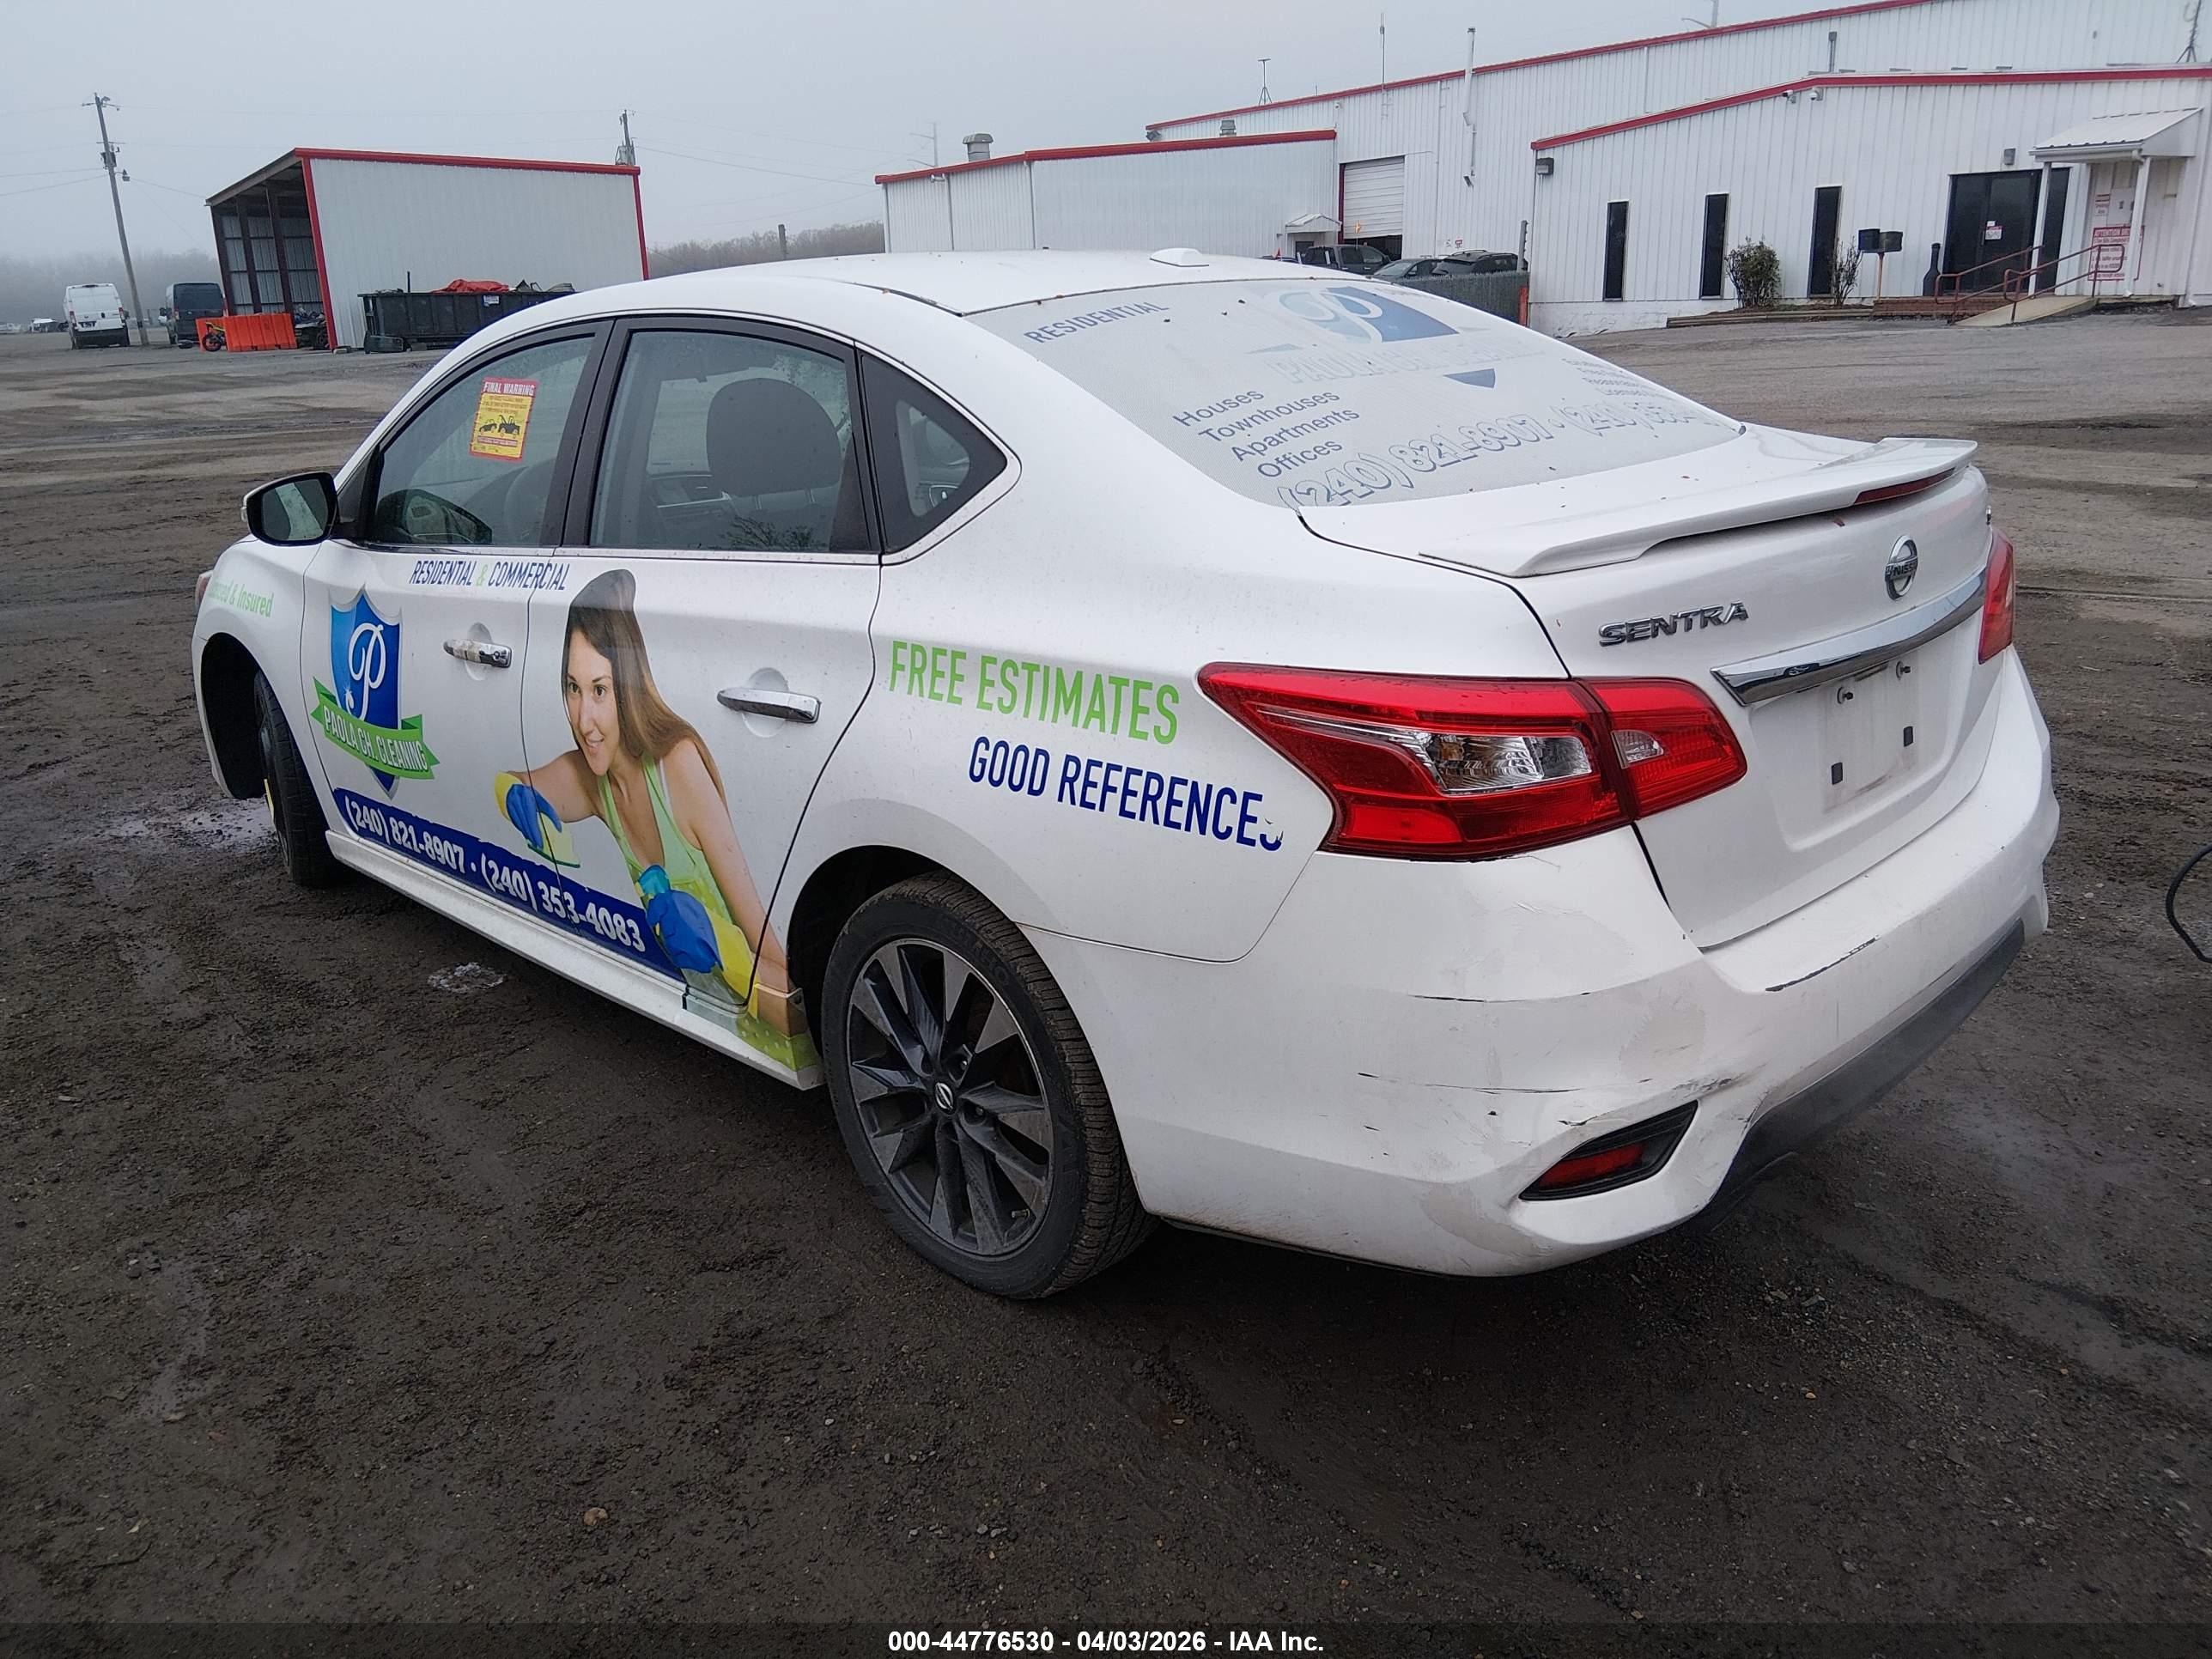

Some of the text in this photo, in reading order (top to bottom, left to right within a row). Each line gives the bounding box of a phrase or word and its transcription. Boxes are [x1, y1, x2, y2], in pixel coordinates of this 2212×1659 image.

[1024, 301, 1170, 343] RESIDENTIAL
[483, 381, 535, 396] FINAL WARNING
[1172, 388, 1264, 427] Houses
[1198, 390, 1340, 442] Townhouses
[1230, 407, 1360, 462] Apartments
[1257, 438, 1342, 477] Offices
[1277, 453, 1414, 514] (240)
[1389, 414, 1554, 472] 821-8907
[409, 560, 570, 590] RESIDENTIAL & COMMERCIAL
[236, 584, 275, 617] Insured
[1598, 600, 1750, 647] SENTRA
[888, 640, 1180, 745] FREE ESTIMATES
[323, 705, 358, 751] PAOLA
[375, 734, 428, 773] CLEANING
[969, 736, 1050, 798] GOOD
[345, 795, 390, 845] (240)
[392, 817, 465, 874] 821-8907
[481, 853, 538, 912] (240)
[537, 880, 646, 953] 353-4083
